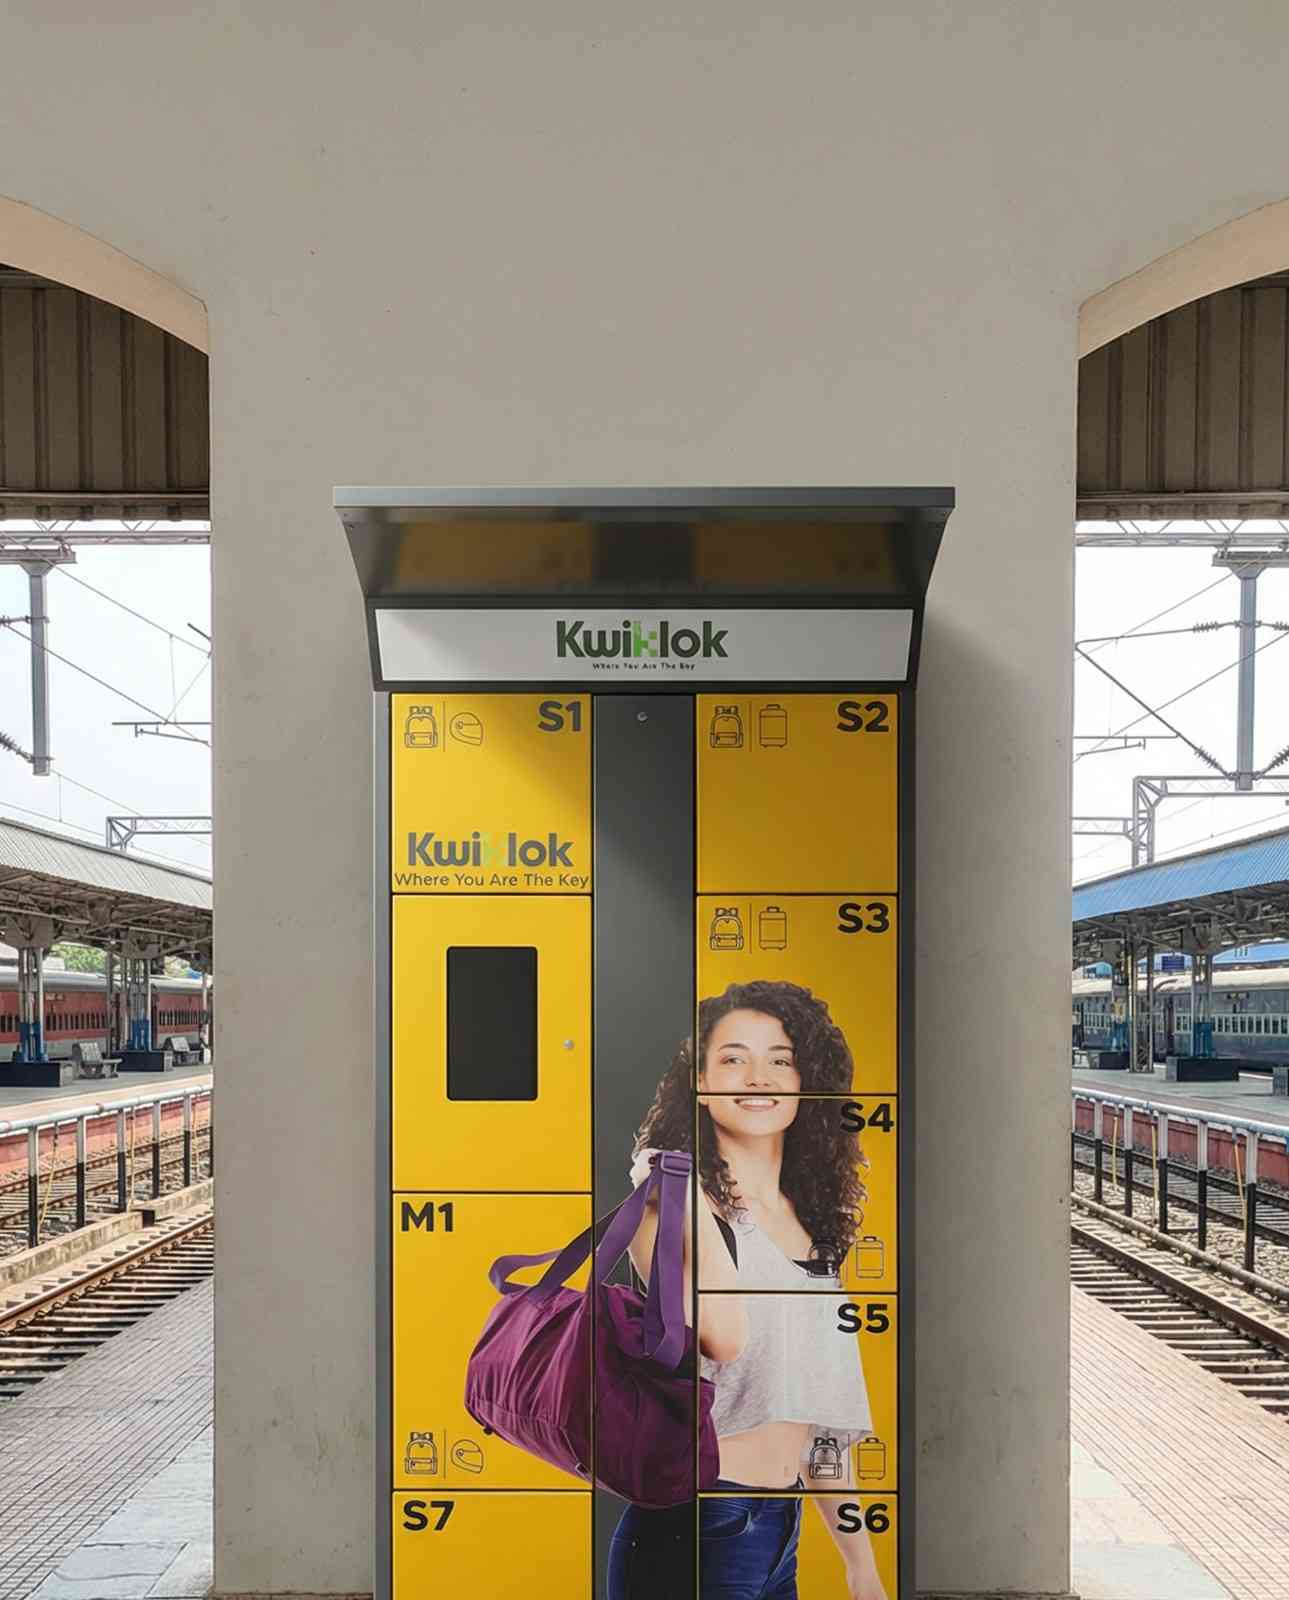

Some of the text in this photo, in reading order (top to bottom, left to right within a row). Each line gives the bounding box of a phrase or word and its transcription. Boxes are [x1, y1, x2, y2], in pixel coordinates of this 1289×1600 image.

[556, 619, 729, 658] Kwiklok
[537, 700, 582, 732] S1
[836, 700, 890, 733] S2
[394, 872, 590, 889] Where You Are The Key
[837, 902, 890, 934] S3
[839, 1101, 895, 1133] S4
[401, 1201, 454, 1233] M1
[836, 1302, 890, 1334] S5
[402, 1500, 455, 1531] S7
[836, 1502, 890, 1534] S6
